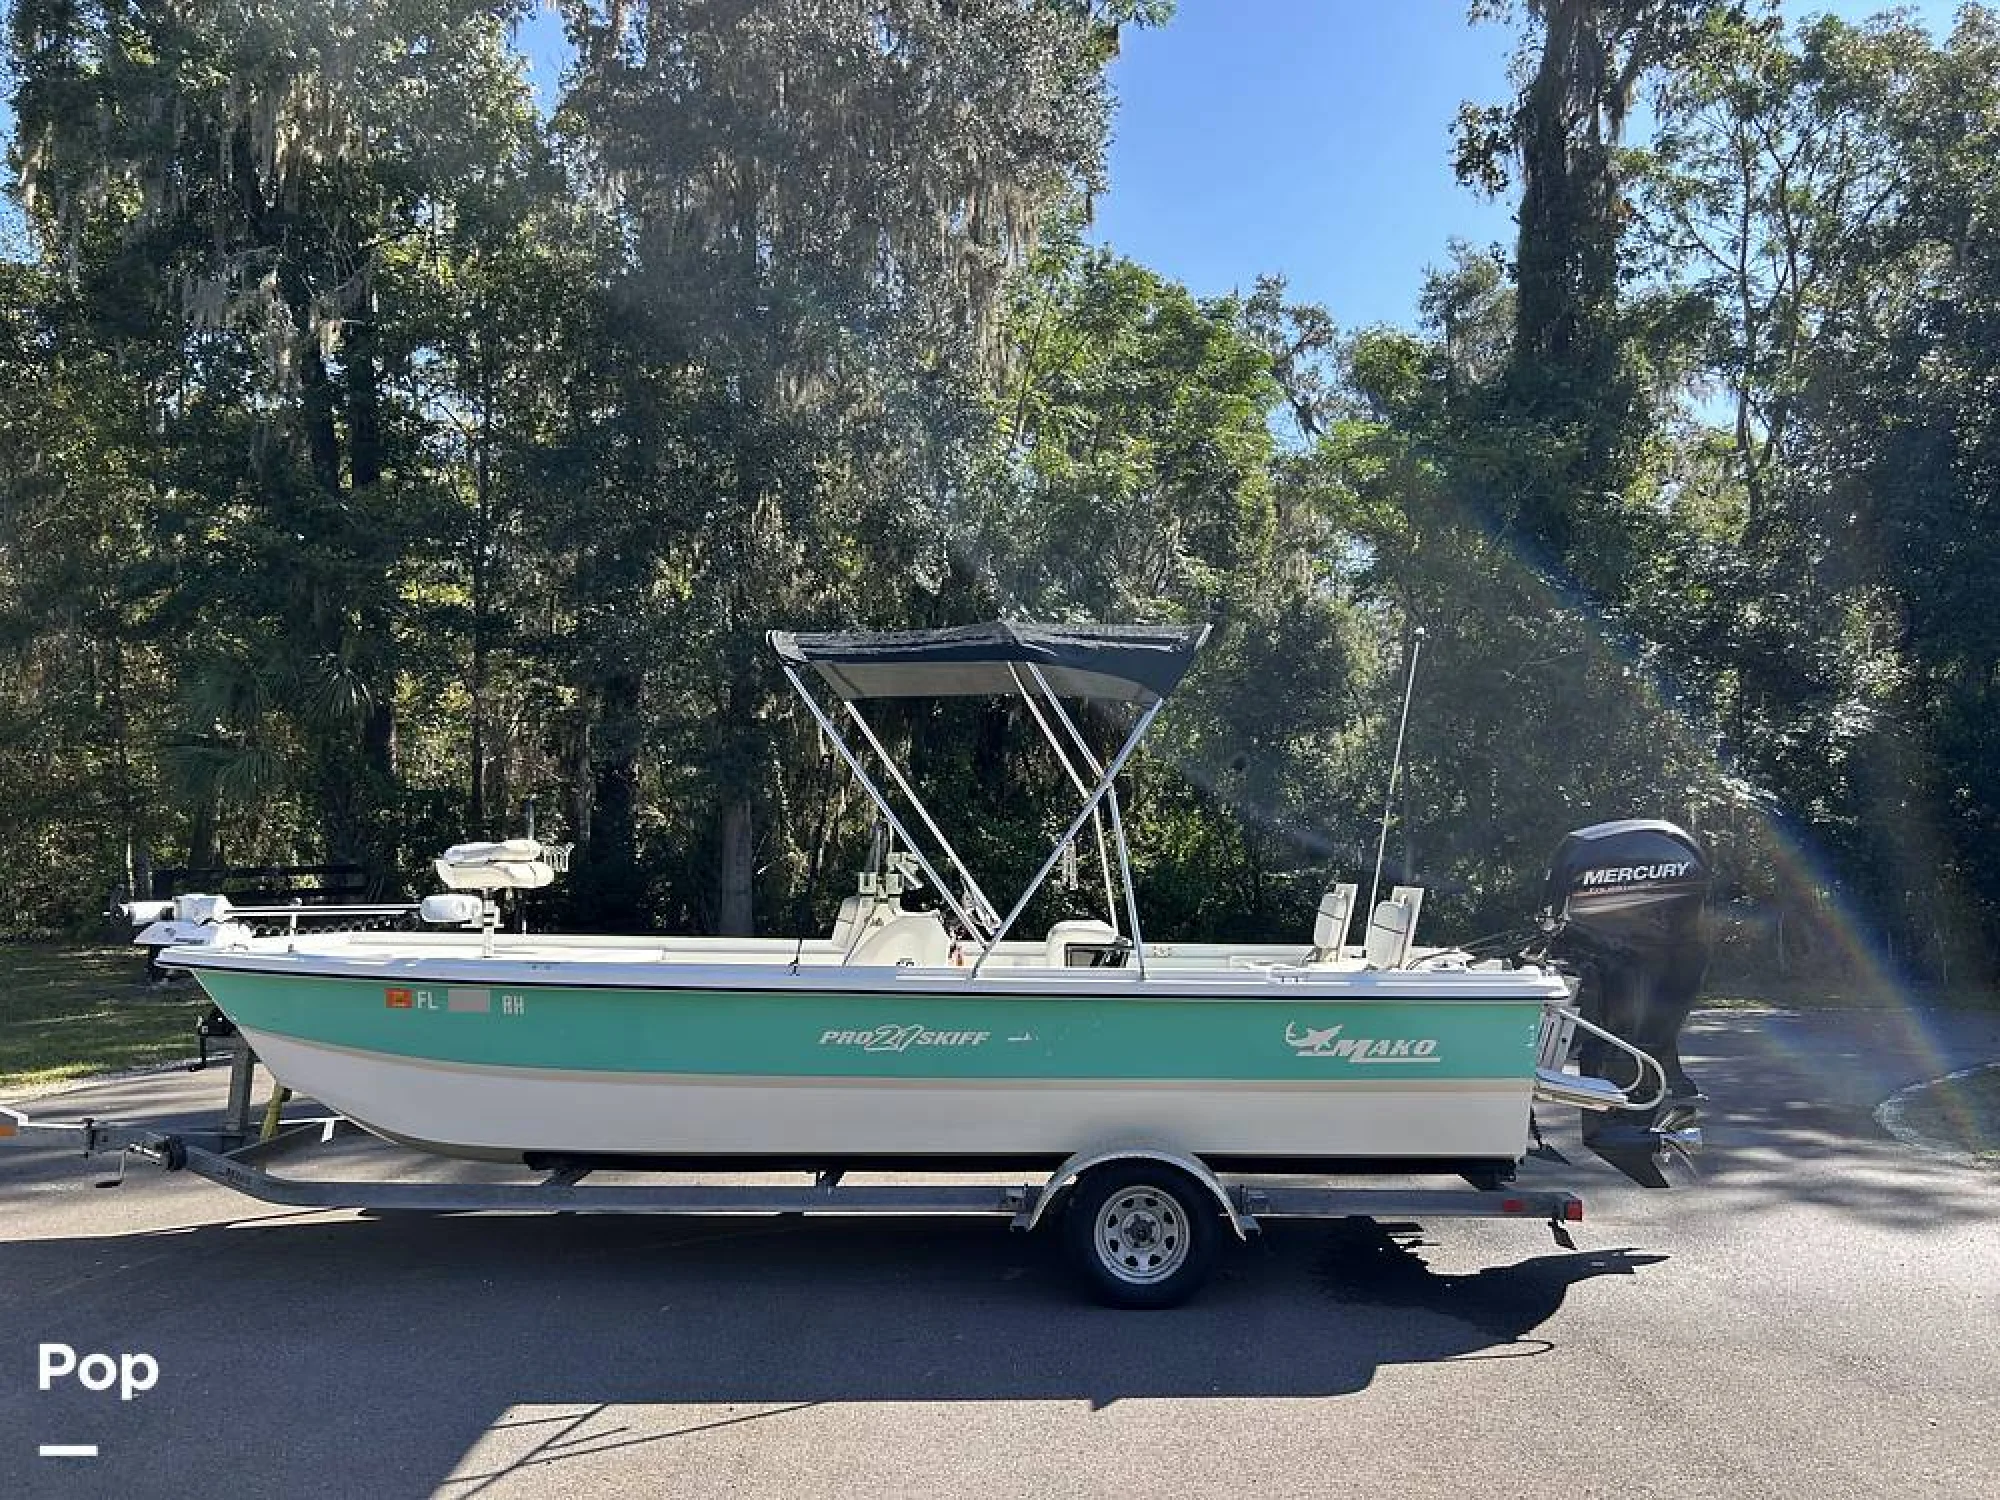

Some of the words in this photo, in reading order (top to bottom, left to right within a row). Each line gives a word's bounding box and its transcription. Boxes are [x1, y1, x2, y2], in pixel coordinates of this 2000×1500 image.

[1583, 861, 1690, 885] MERCURY
[417, 991, 438, 1009] FL
[819, 1031, 873, 1045] PRO
[917, 1031, 991, 1045] SKIFF
[1334, 1039, 1440, 1062] MAKO
